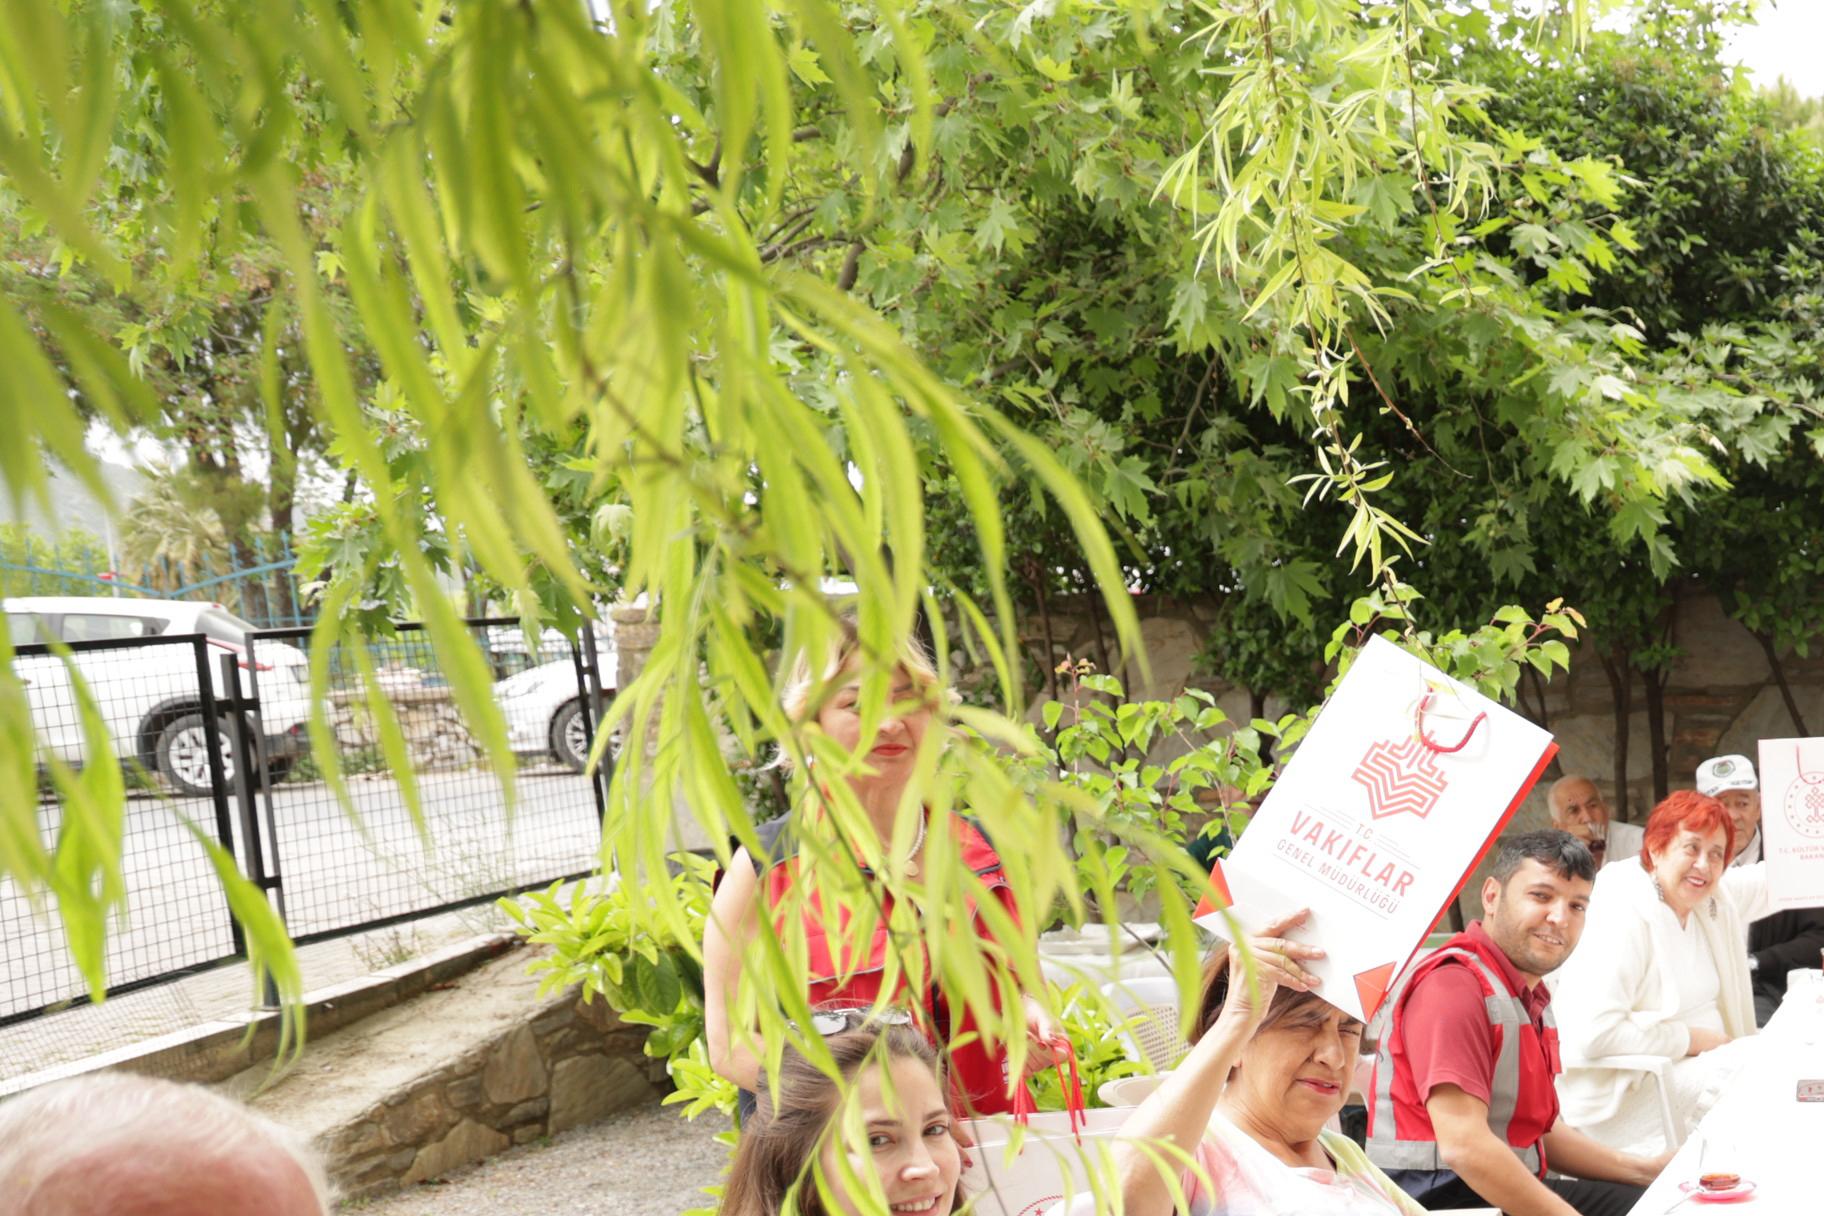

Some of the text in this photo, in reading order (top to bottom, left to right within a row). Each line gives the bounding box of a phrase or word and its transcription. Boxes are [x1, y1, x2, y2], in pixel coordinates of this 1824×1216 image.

[1276, 839, 1401, 914] GENEL MÜDÜRLÜĞÜ
[1290, 811, 1415, 897] VAKIFLAR
